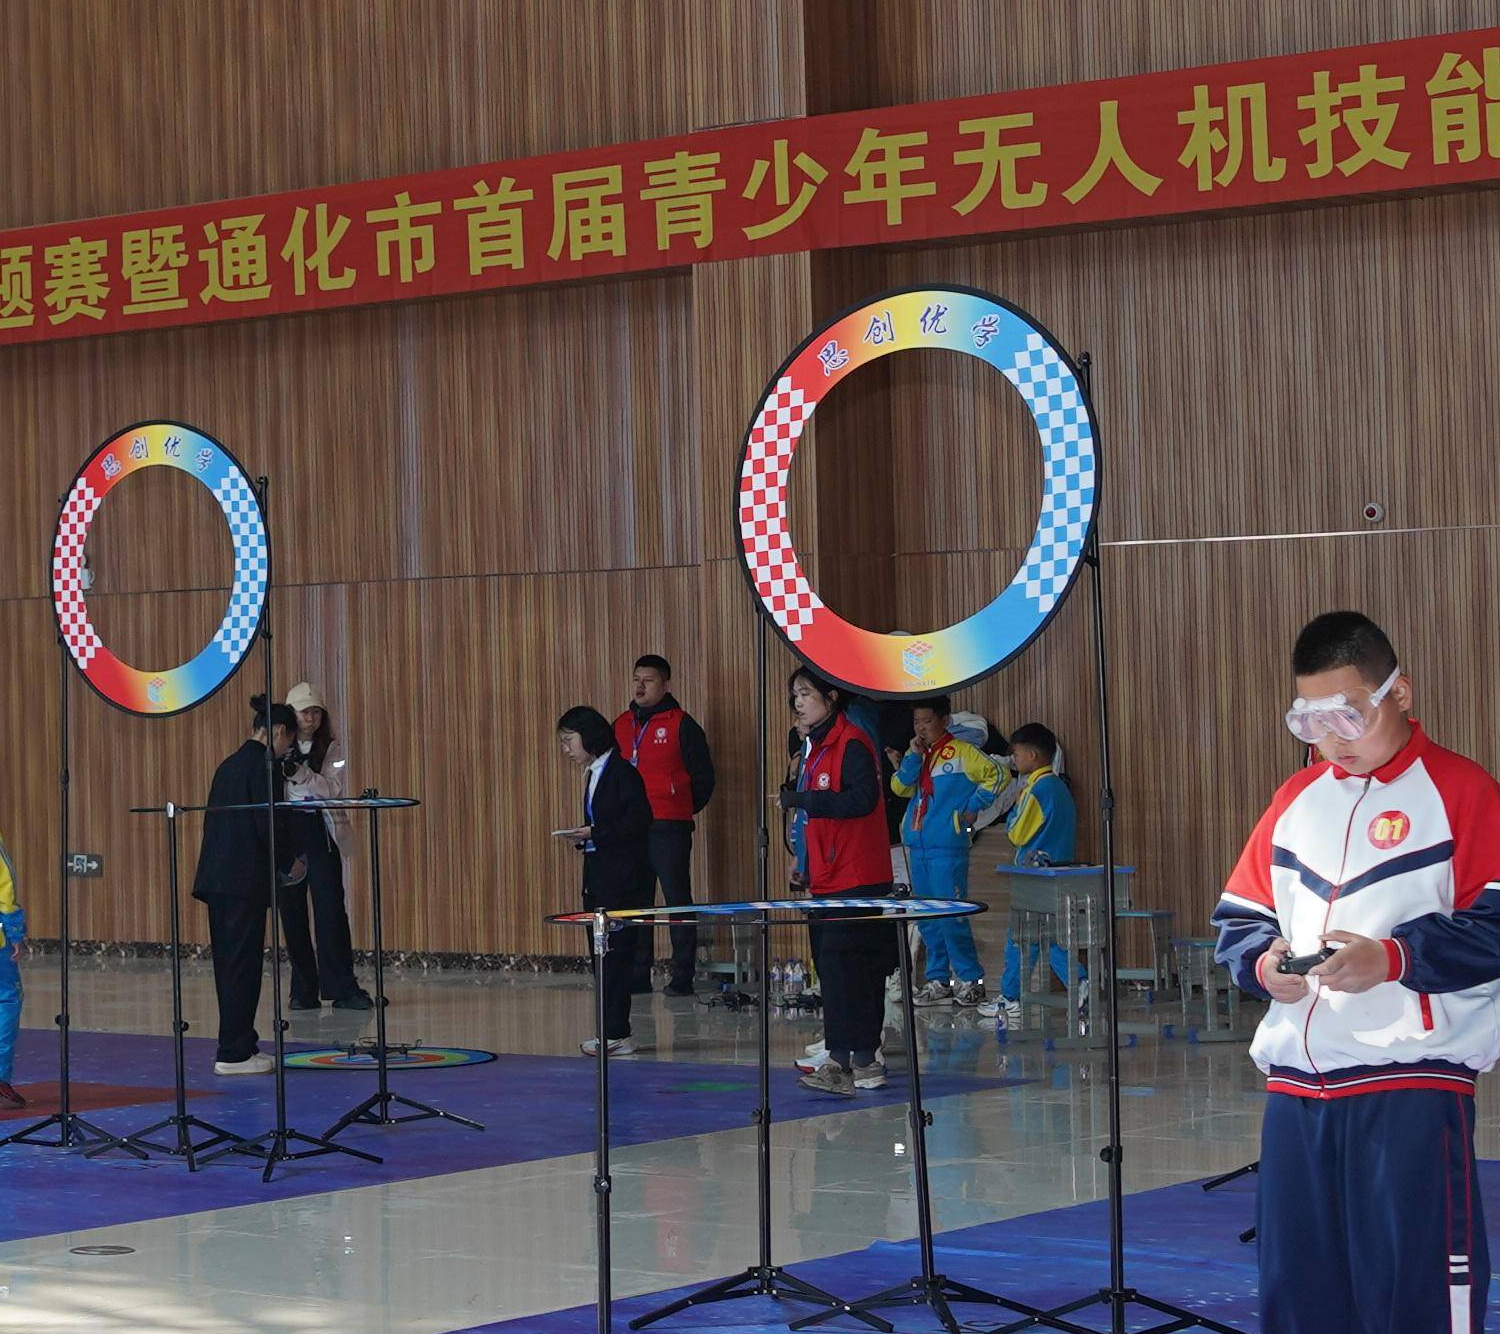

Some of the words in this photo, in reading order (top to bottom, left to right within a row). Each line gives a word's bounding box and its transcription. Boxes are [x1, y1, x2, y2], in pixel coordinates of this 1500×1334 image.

[817, 303, 1000, 375] 思创优学
[1374, 817, 1404, 841] 01
